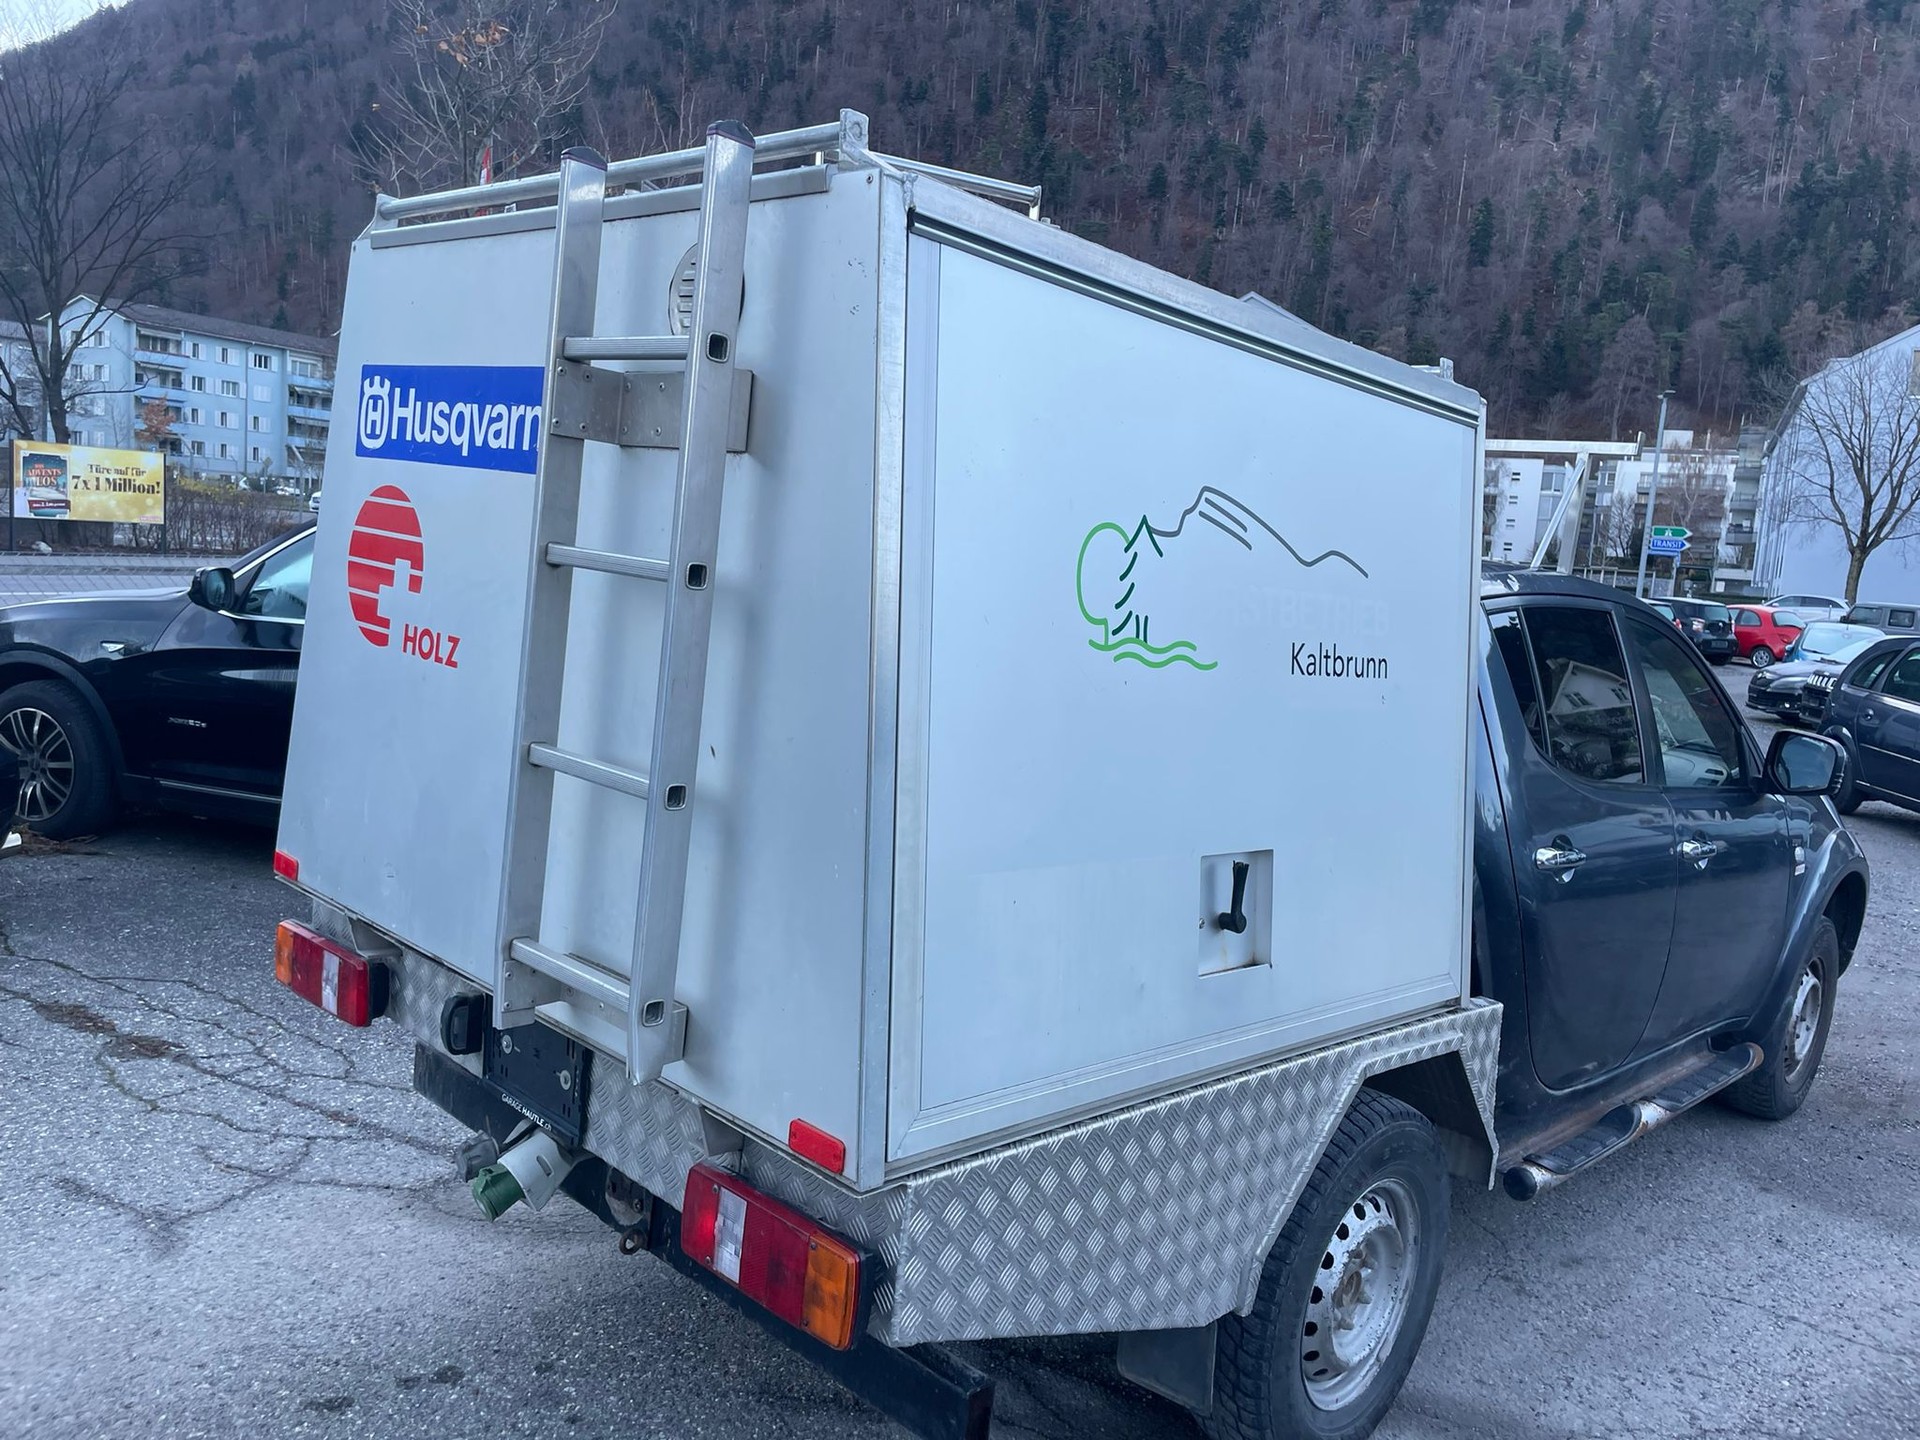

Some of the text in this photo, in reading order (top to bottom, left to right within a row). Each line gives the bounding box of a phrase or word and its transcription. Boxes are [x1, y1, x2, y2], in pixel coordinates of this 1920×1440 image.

[391, 387, 543, 457] Husqvarn
[26, 468, 62, 477] ADVENTS
[87, 464, 147, 477] Türe auf für
[36, 476, 57, 487] LOS
[105, 477, 161, 495] Million!
[1653, 539, 1682, 548] TRANSIT
[402, 623, 461, 669] HOLZ
[1291, 642, 1388, 679] Kaltbrunn
[501, 1093, 523, 1112] GARAGE
